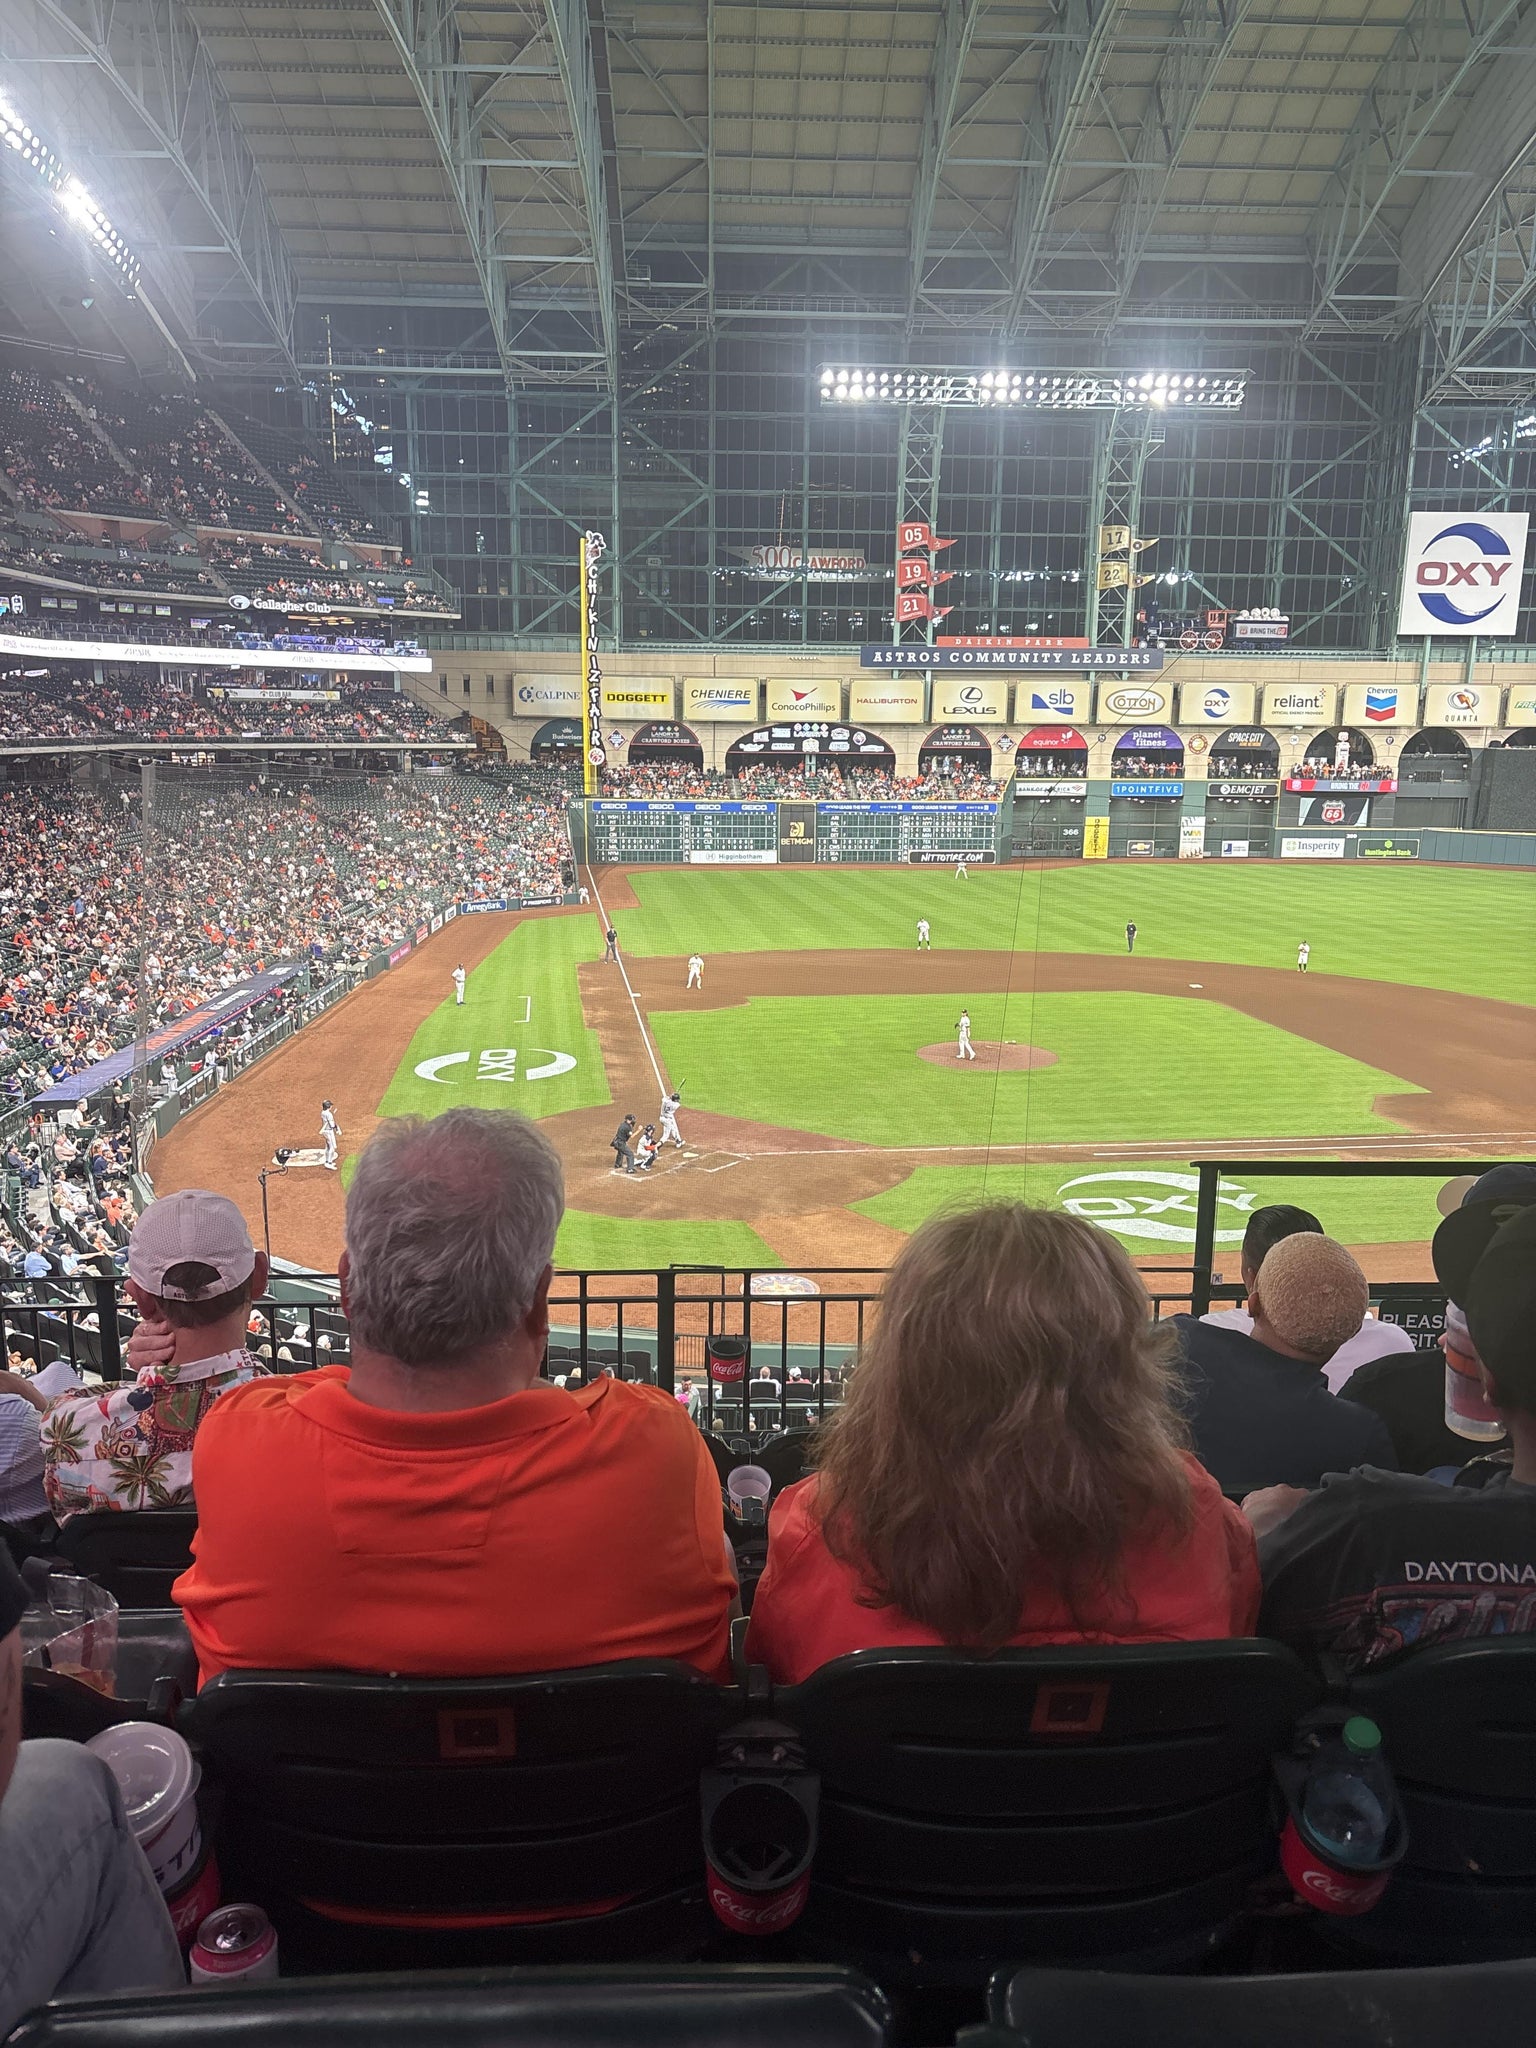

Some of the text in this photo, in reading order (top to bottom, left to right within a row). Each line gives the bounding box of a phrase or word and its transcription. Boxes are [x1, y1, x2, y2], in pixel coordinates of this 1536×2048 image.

[905, 528, 922, 542] 05
[1107, 532, 1122, 545] 17
[752, 546, 792, 569] 500
[793, 557, 866, 569] CAWFORD
[905, 566, 922, 578] 19
[1104, 569, 1120, 581] 22
[1416, 562, 1513, 586] OXY
[253, 598, 331, 613] Gallagher Club
[586, 565, 599, 652] CHIKIN
[903, 599, 919, 612] 21
[873, 652, 1151, 664] ASTROS COMMUNITY LEADERS
[536, 691, 580, 700] CALPINE
[607, 694, 667, 702] DOGGETT
[691, 690, 750, 699] CHENIERE
[1049, 688, 1074, 704] slb
[772, 702, 836, 712] ConocoPhillips
[1274, 695, 1320, 708] reliant
[943, 706, 996, 714] LEXUS
[590, 687, 601, 746] FAIR
[1132, 730, 1162, 740] planet
[1228, 732, 1266, 742] SPACE CITY
[1032, 739, 1060, 747] equinor
[1136, 738, 1166, 747] fitness
[1116, 785, 1178, 793] 1POINTFIVE
[1231, 786, 1266, 795] EMCJET
[1326, 810, 1342, 818] 66
[1298, 841, 1340, 851] Insperity
[921, 853, 983, 862] NITTOTIRE.COM
[466, 902, 502, 912] AmegyBank
[476, 1048, 517, 1082] OXY
[1062, 1194, 1258, 1215] OXY
[712, 1362, 743, 1375] Coca-Cola
[1404, 1561, 1536, 1584] DAYTONA
[712, 1887, 802, 1924] Coca-Cola
